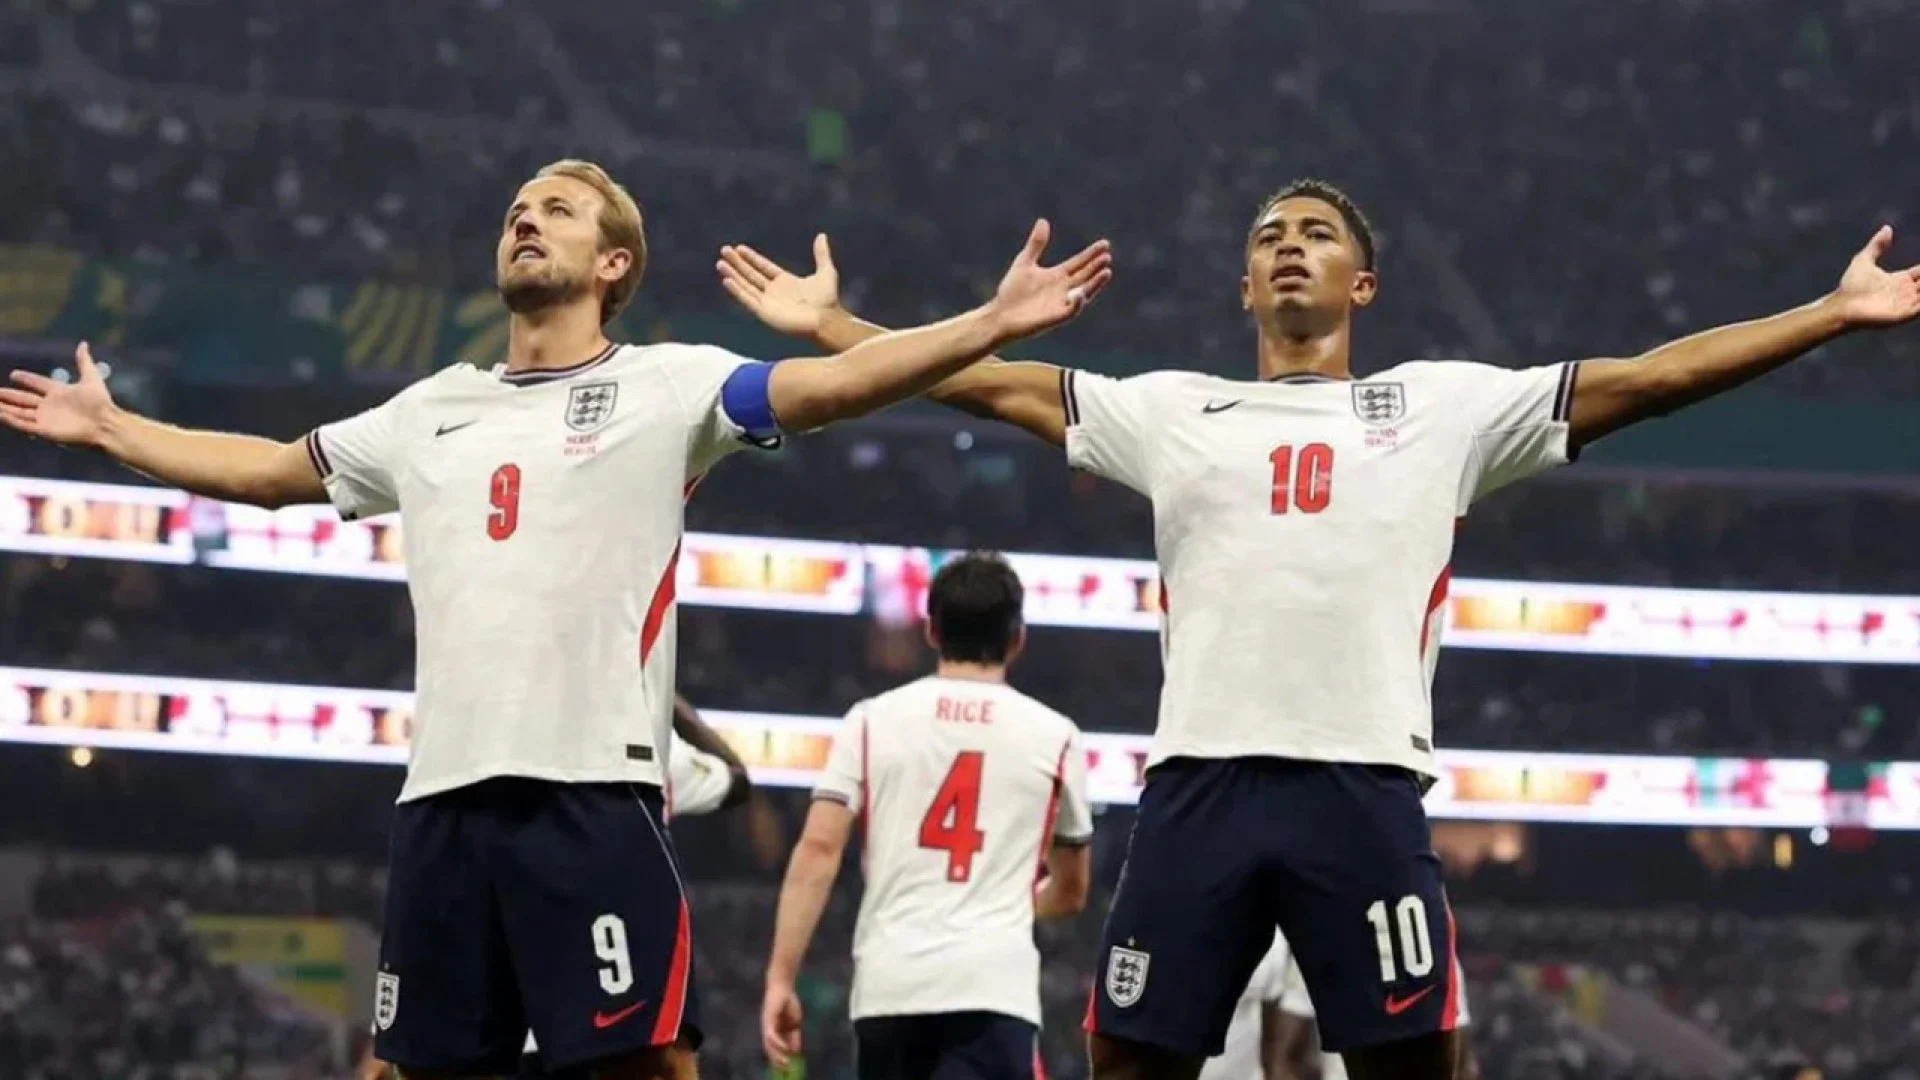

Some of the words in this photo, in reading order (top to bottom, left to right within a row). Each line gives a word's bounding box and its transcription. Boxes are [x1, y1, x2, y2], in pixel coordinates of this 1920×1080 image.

[487, 463, 520, 540] 9
[1269, 443, 1333, 515] 10
[936, 696, 997, 724] RICE
[918, 751, 984, 882] 4
[592, 913, 633, 994] 9
[1366, 895, 1433, 981] 10
